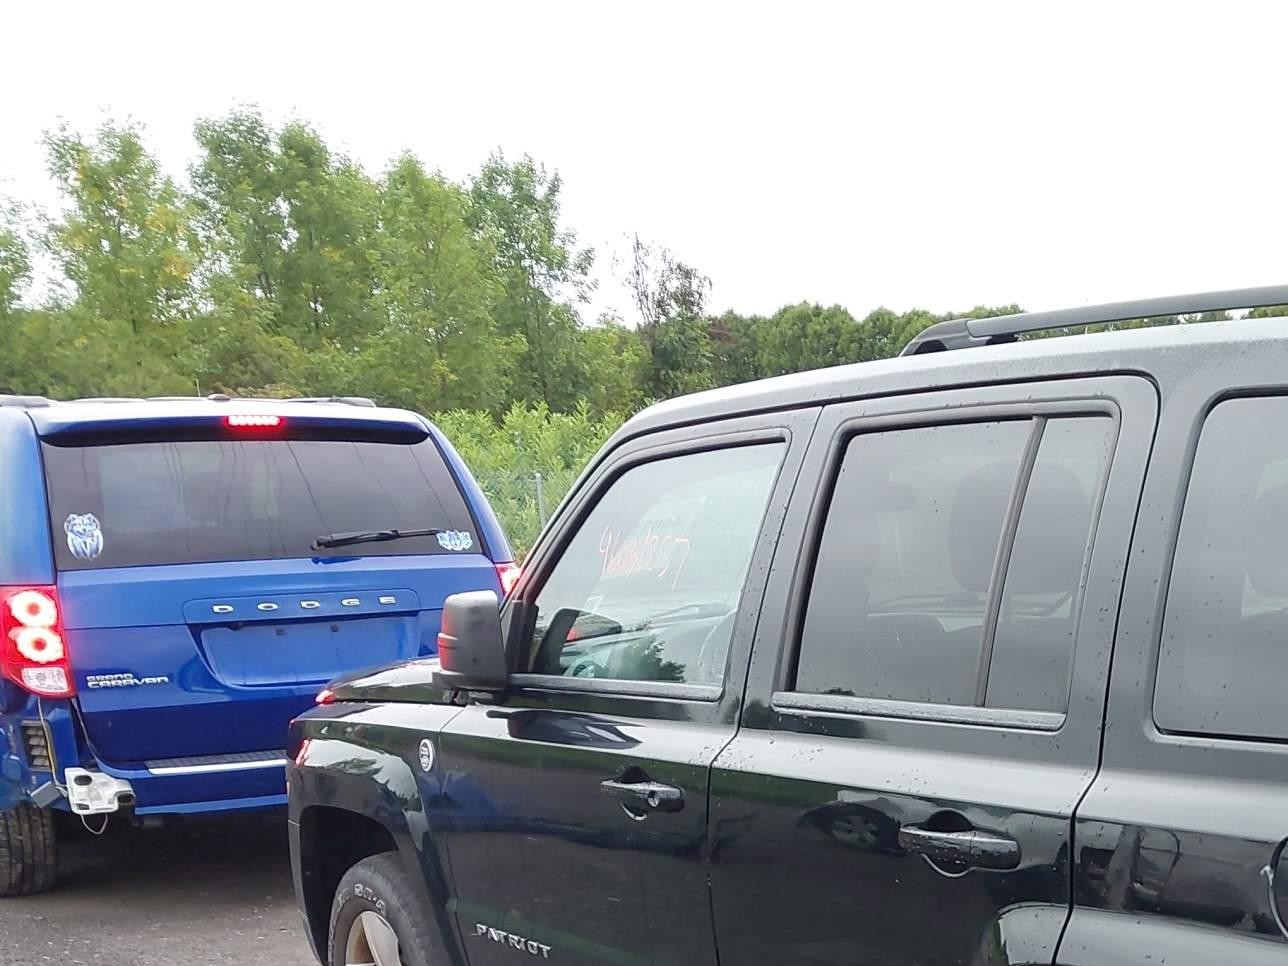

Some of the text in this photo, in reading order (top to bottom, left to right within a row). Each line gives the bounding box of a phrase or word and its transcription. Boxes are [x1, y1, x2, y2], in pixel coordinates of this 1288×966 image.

[212, 596, 397, 613] DODGE
[86, 673, 134, 682] GRAND
[87, 676, 169, 689] CARAVAN
[475, 923, 552, 958] PATRIOT
